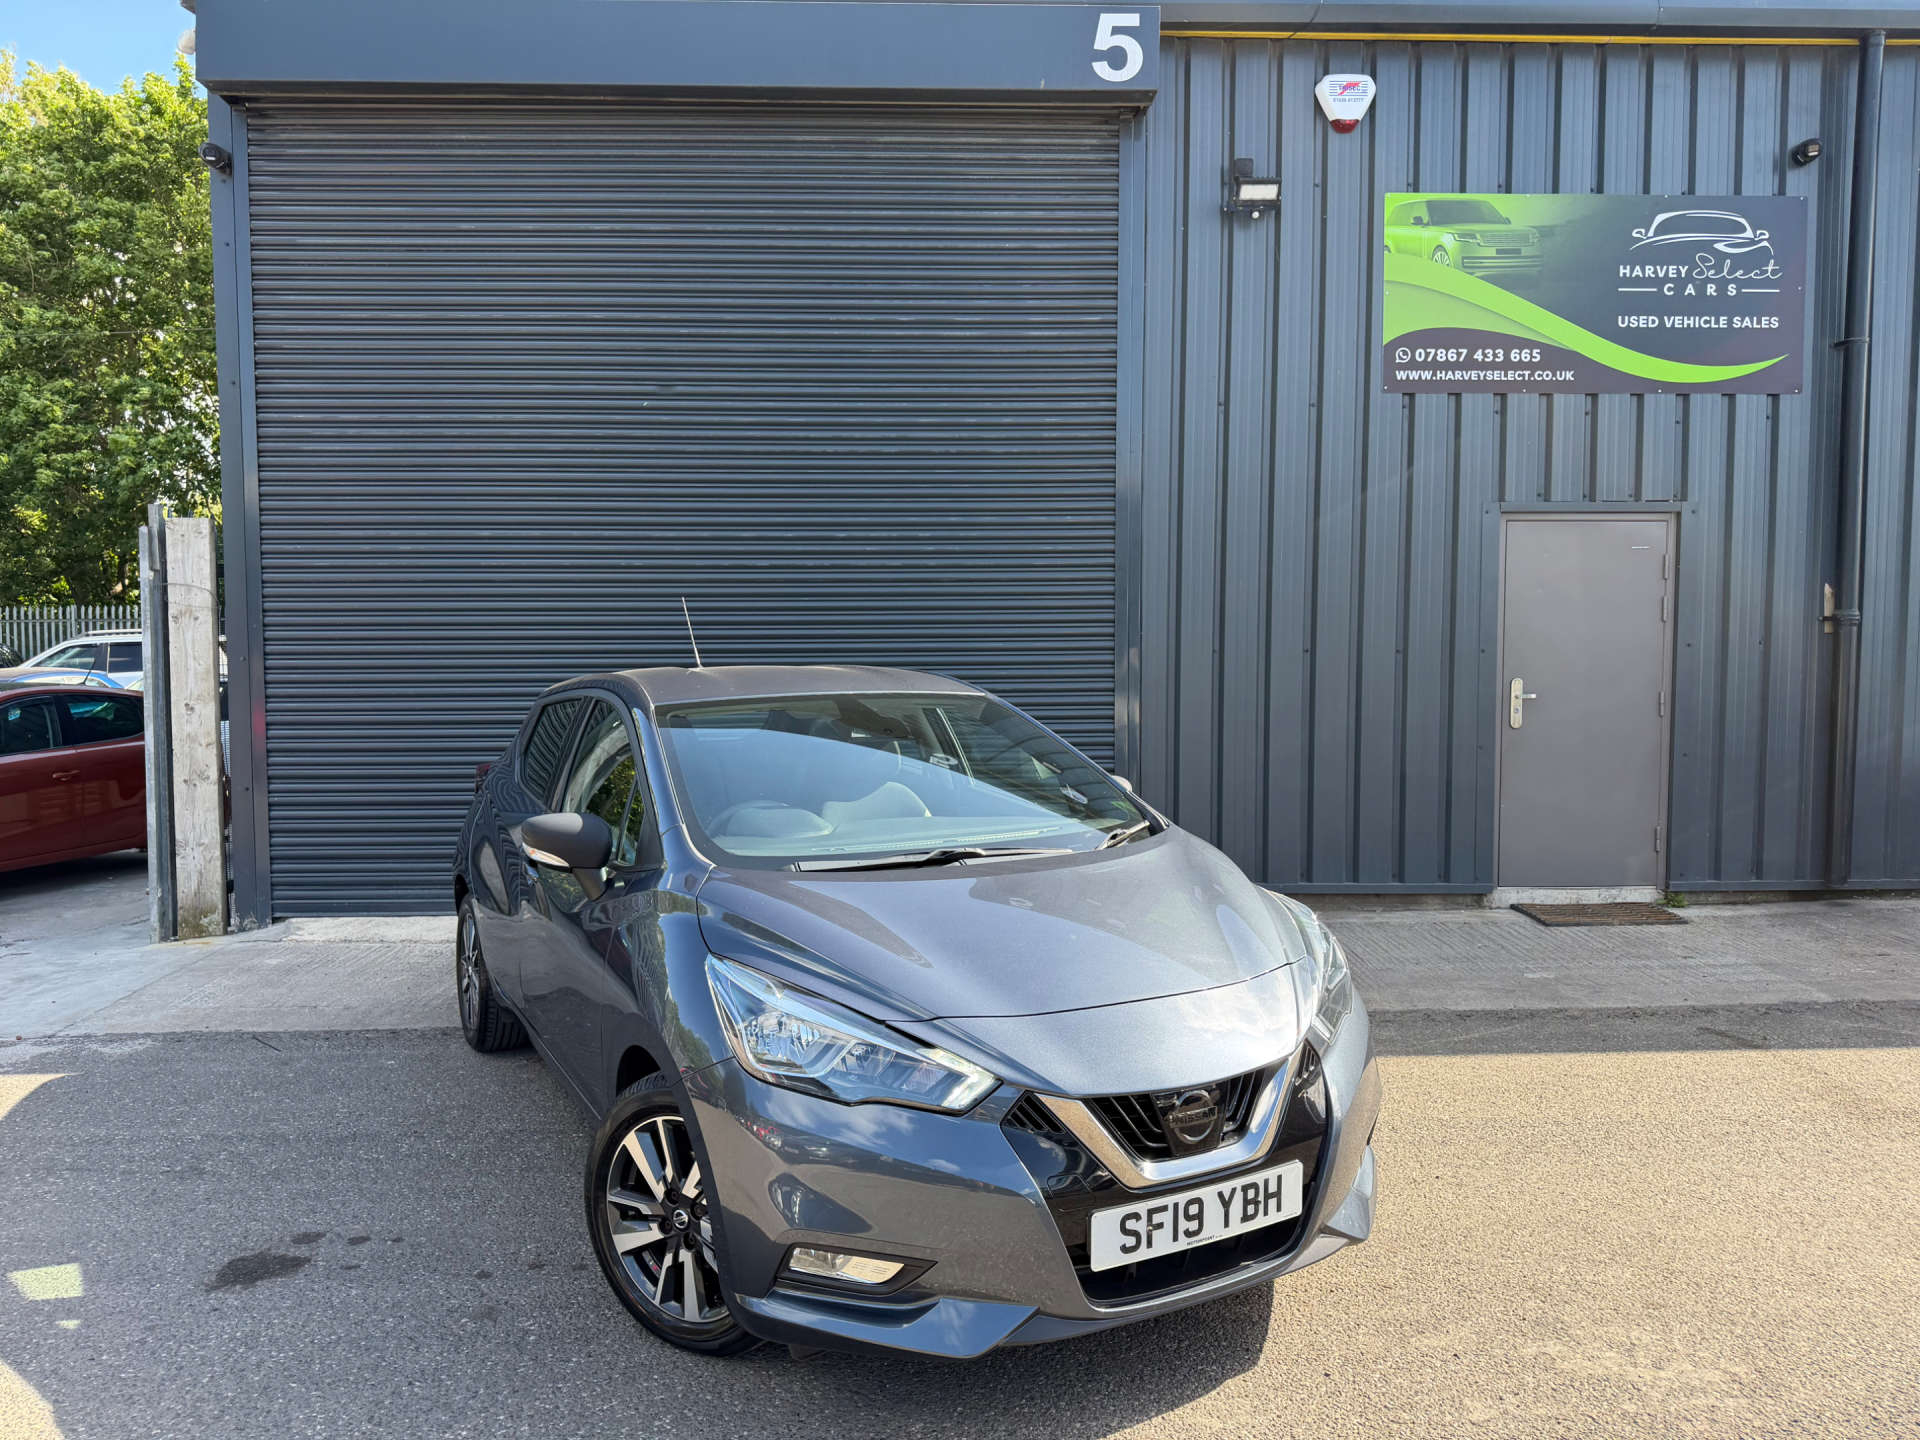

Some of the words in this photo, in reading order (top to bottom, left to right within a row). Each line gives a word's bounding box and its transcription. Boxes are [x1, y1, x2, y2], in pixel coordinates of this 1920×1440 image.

[1091, 13, 1143, 82] 5
[1619, 265, 1689, 278] HARVEY
[1692, 252, 1783, 279] Select
[1663, 283, 1737, 296] CARS
[1617, 315, 1659, 328] USED
[1664, 315, 1728, 328] VEHICLE
[1732, 316, 1779, 329] SALES
[1415, 348, 1468, 362] 07867
[1473, 348, 1505, 362] 433
[1510, 348, 1541, 362] 665
[1395, 370, 1575, 381] WWW.HARVEYSELECT.CO.UK
[1119, 1196, 1205, 1254] SF19
[1217, 1174, 1283, 1229] YBH
